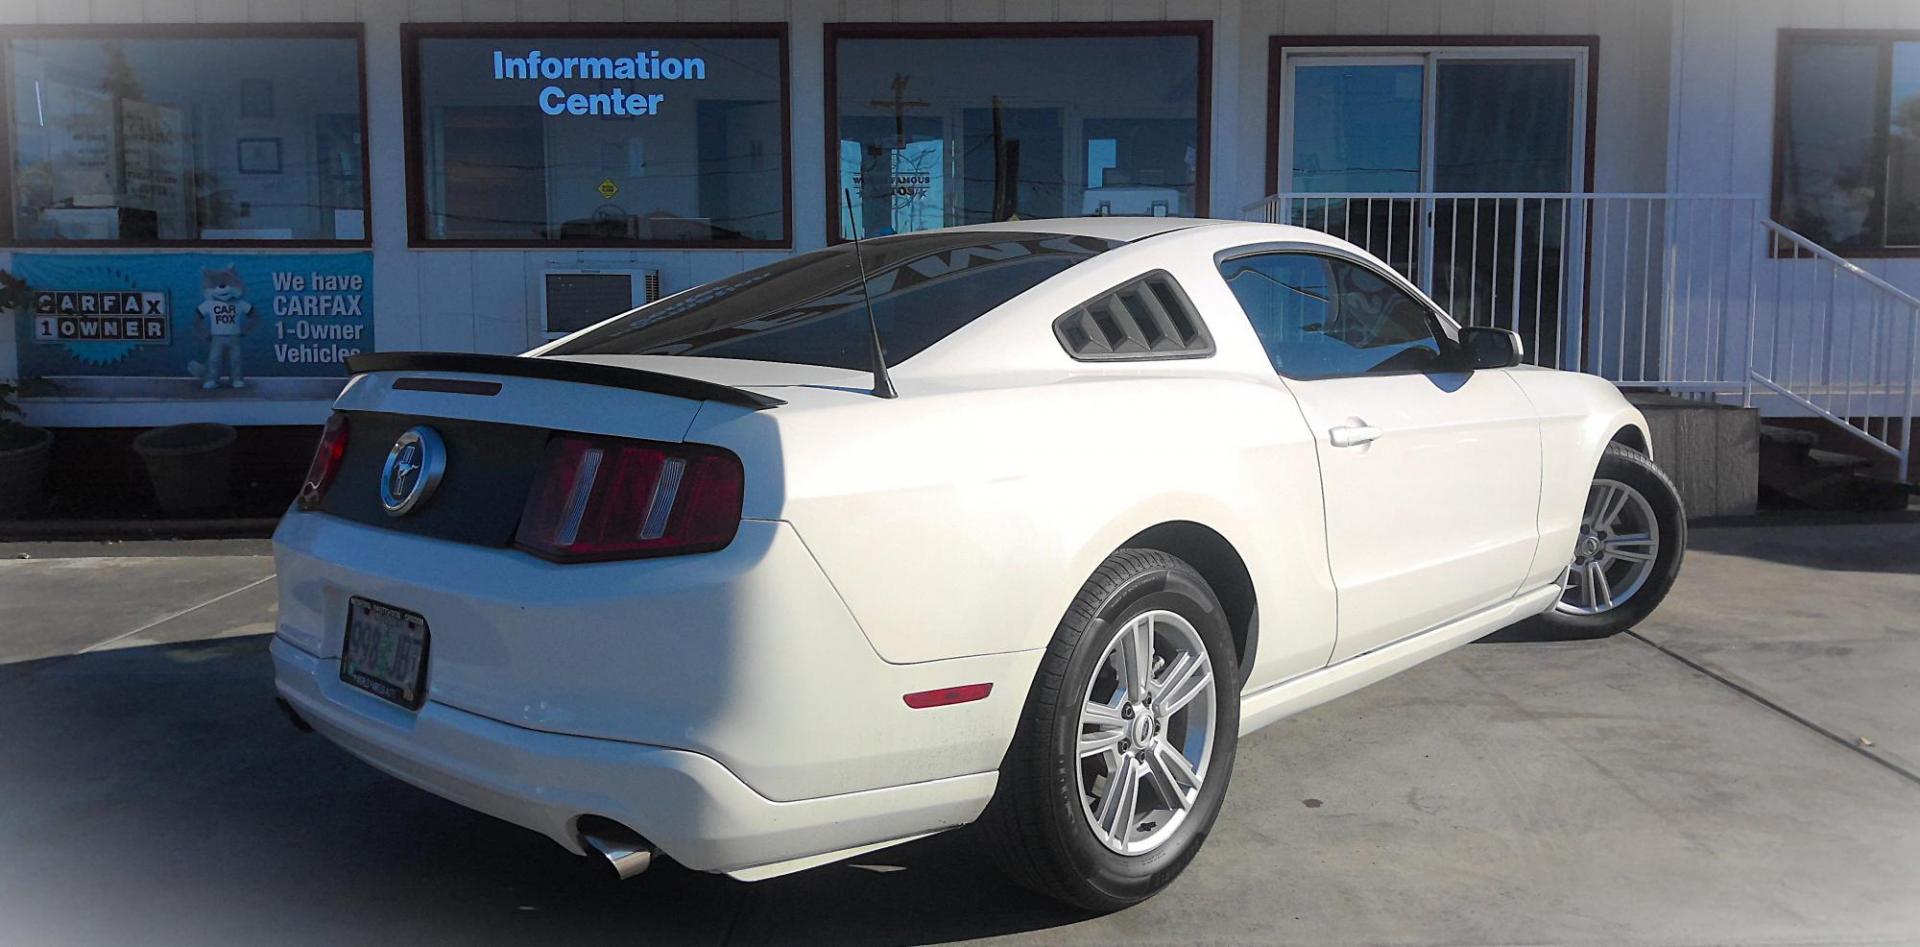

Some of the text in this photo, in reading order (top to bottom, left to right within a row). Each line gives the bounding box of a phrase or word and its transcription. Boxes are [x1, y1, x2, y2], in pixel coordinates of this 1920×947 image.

[493, 51, 706, 80] Information
[539, 86, 664, 115] Center
[272, 272, 362, 291] We have
[38, 294, 161, 316] CARFAX
[213, 305, 236, 315] CAR
[272, 295, 362, 316] CARFAX
[214, 314, 236, 324] FOX
[274, 320, 363, 340] 1-Owner
